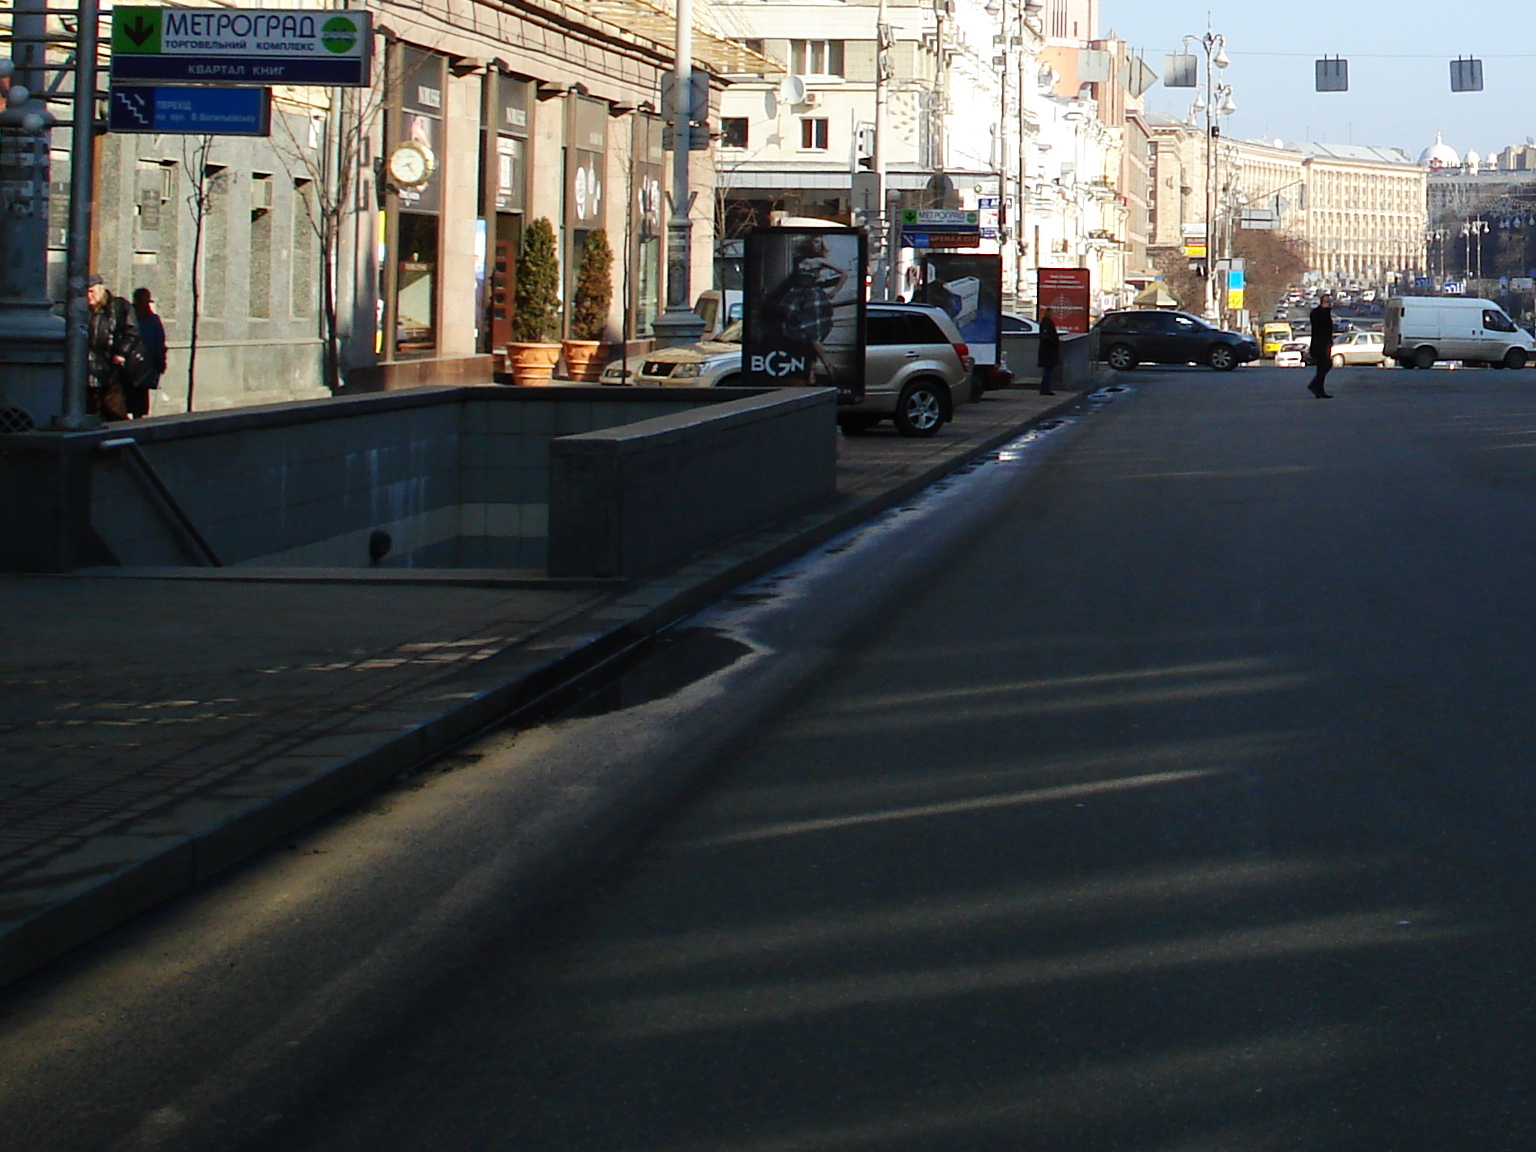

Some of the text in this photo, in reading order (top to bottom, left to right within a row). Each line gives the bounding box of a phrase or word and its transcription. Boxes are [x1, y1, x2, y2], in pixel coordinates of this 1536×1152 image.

[166, 13, 317, 39] МЕТРОГРАД
[165, 39, 315, 52] ТОРГОВЕЛЬНИЙ КОМПЛЕКС
[188, 64, 286, 77] КВАРТАЛ КНИГ
[750, 350, 805, 377] BGN
